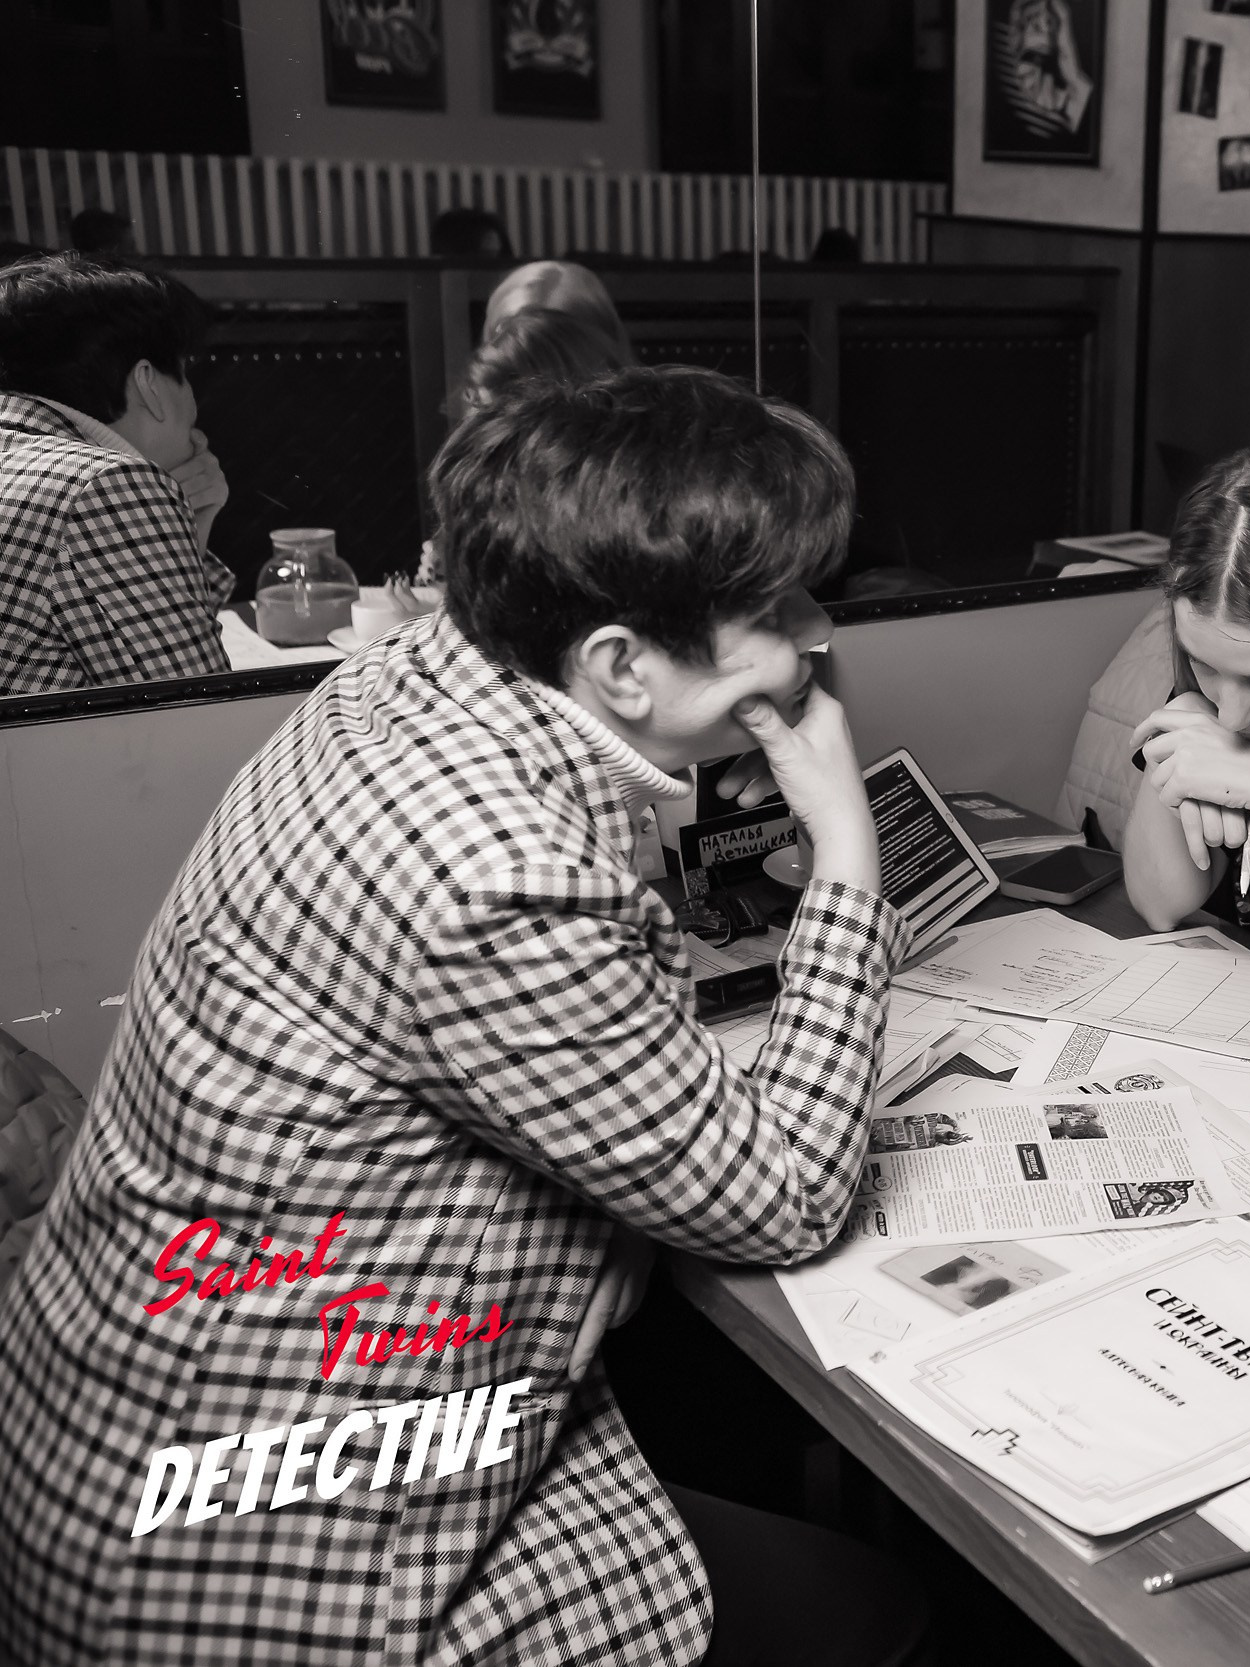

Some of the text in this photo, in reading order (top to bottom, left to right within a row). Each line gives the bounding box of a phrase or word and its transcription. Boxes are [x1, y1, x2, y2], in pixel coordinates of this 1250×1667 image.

[701, 825, 763, 852] НАТАЛЬЯ
[1153, 1319, 1248, 1381] И ОКРАИНЫ
